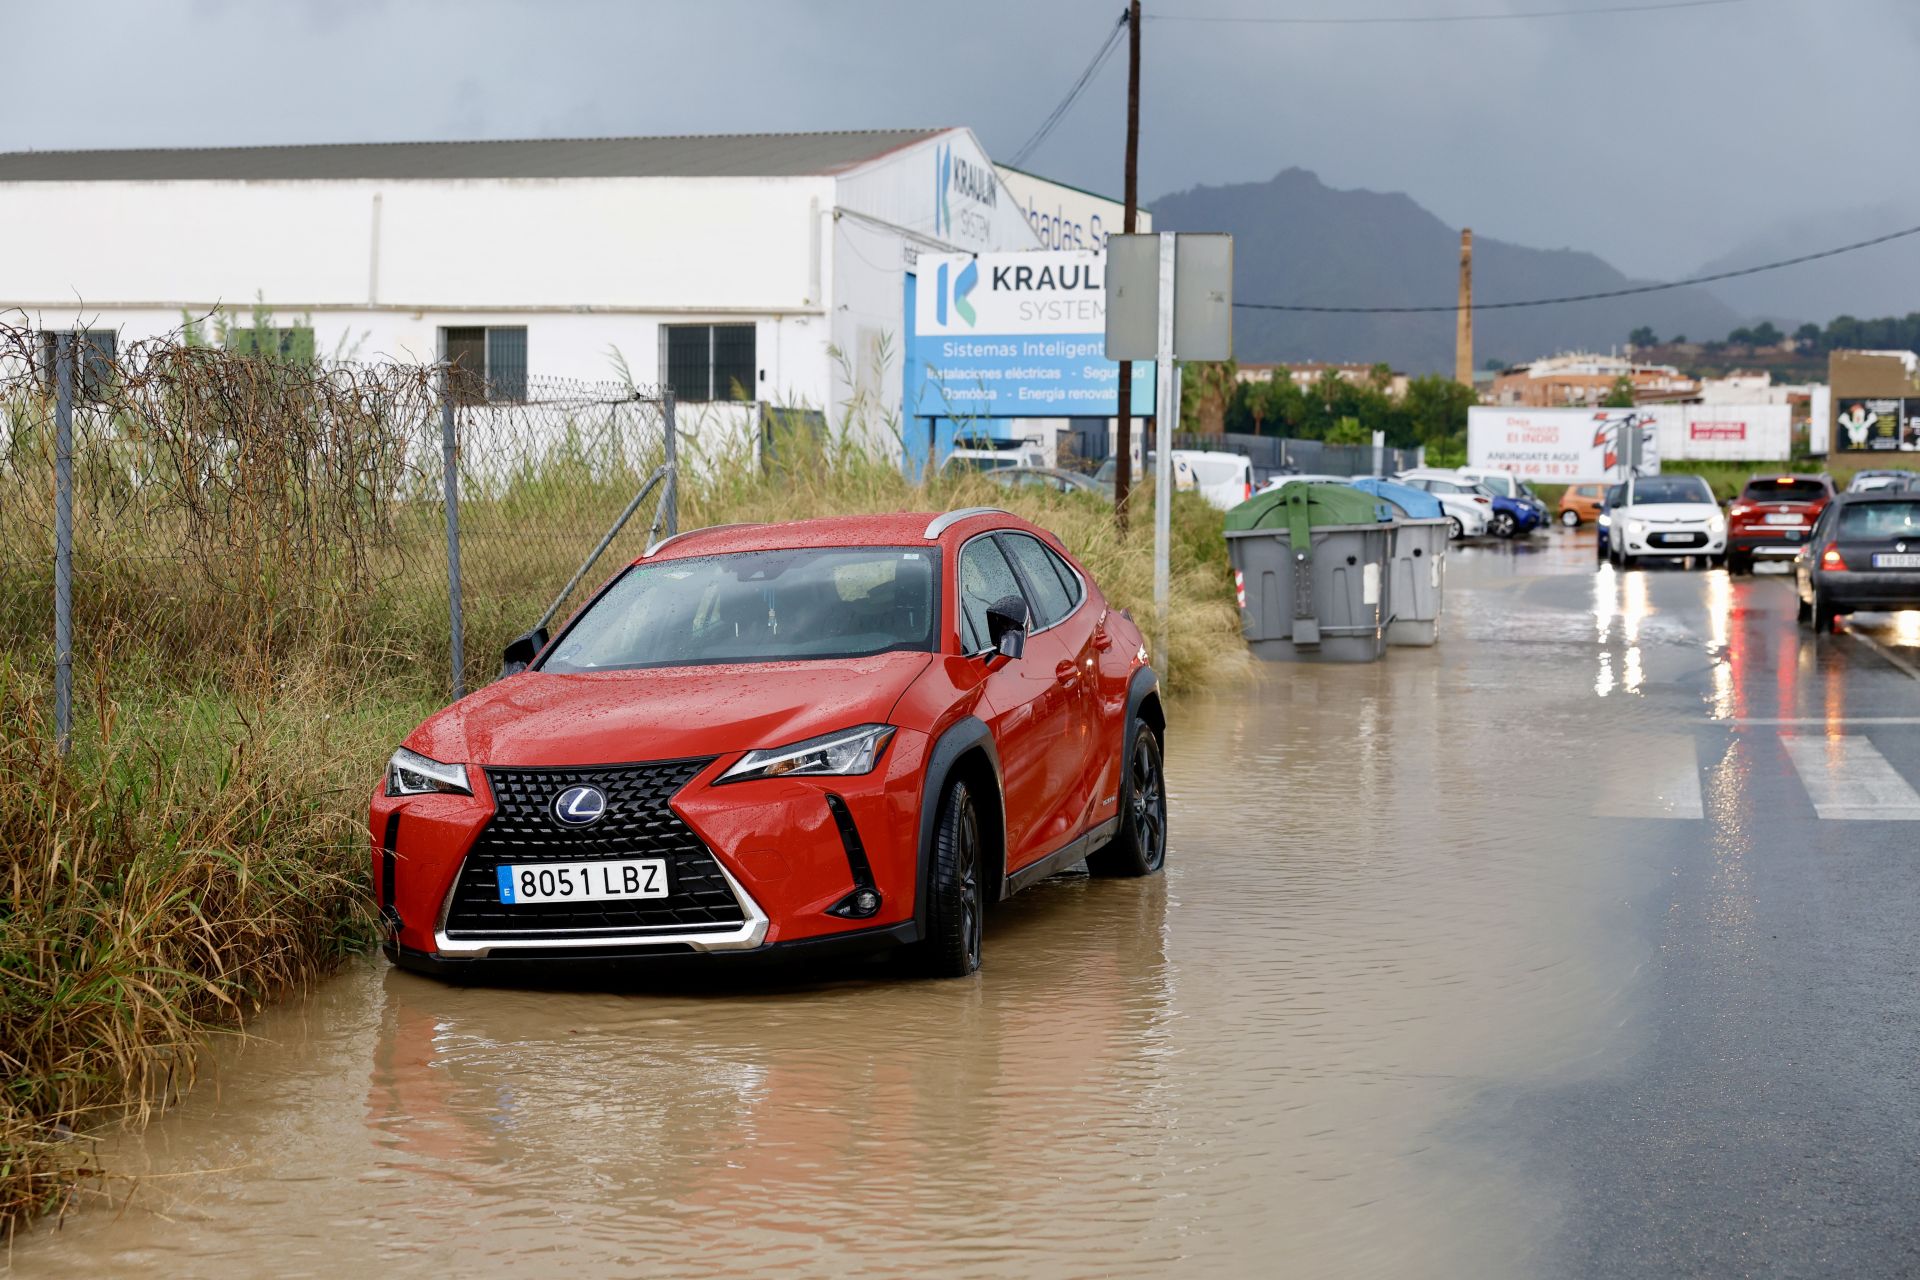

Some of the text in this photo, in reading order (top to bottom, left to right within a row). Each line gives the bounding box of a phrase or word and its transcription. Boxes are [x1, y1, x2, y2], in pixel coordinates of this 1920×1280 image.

[953, 156, 997, 210] KRAULIN
[942, 341, 1105, 360] Sistemas Inteligent
[926, 366, 1002, 380] Instalaciones
[1004, 365, 1062, 380] eléctricas
[1082, 365, 1146, 382] Segurad
[1018, 386, 1066, 403] Energía
[1068, 386, 1120, 401] renovab
[520, 867, 591, 898] 8051
[602, 864, 661, 895] LBZ
